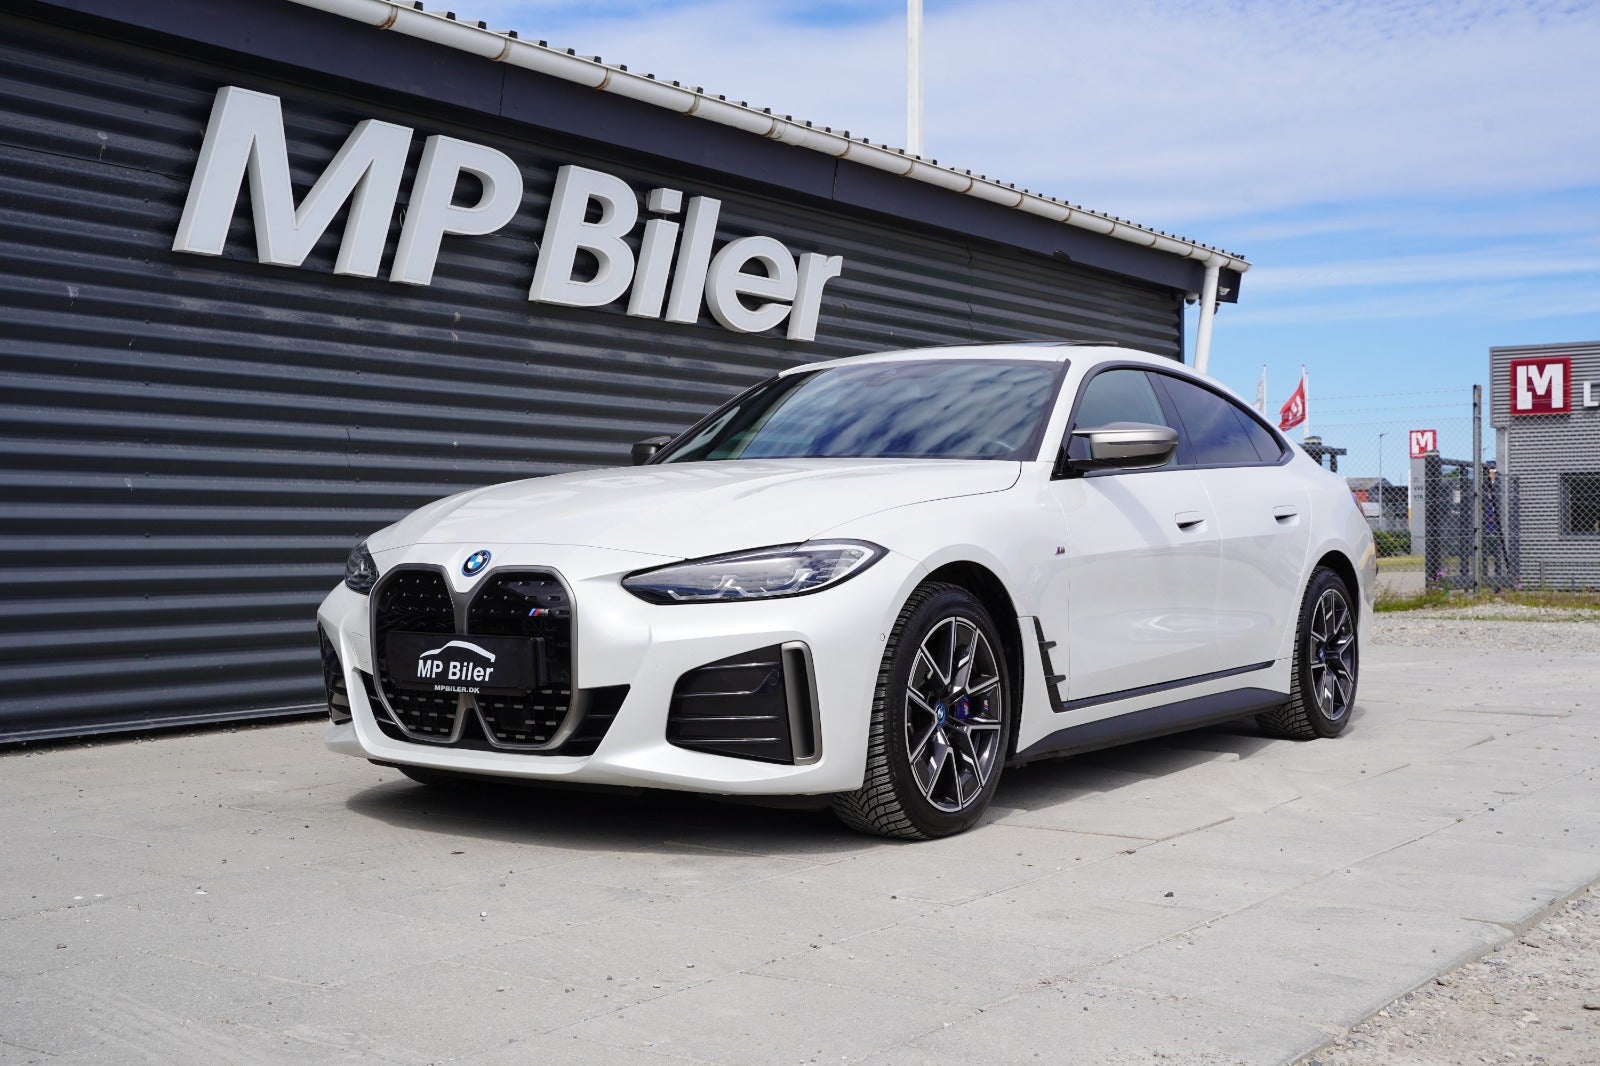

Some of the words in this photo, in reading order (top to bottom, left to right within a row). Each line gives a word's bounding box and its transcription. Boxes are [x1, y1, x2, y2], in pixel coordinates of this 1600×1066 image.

[172, 86, 524, 286] MP
[529, 165, 843, 341] Biler
[417, 659, 443, 679] MP
[448, 661, 494, 682] Biler
[434, 685, 480, 694] MPBILER.DK
